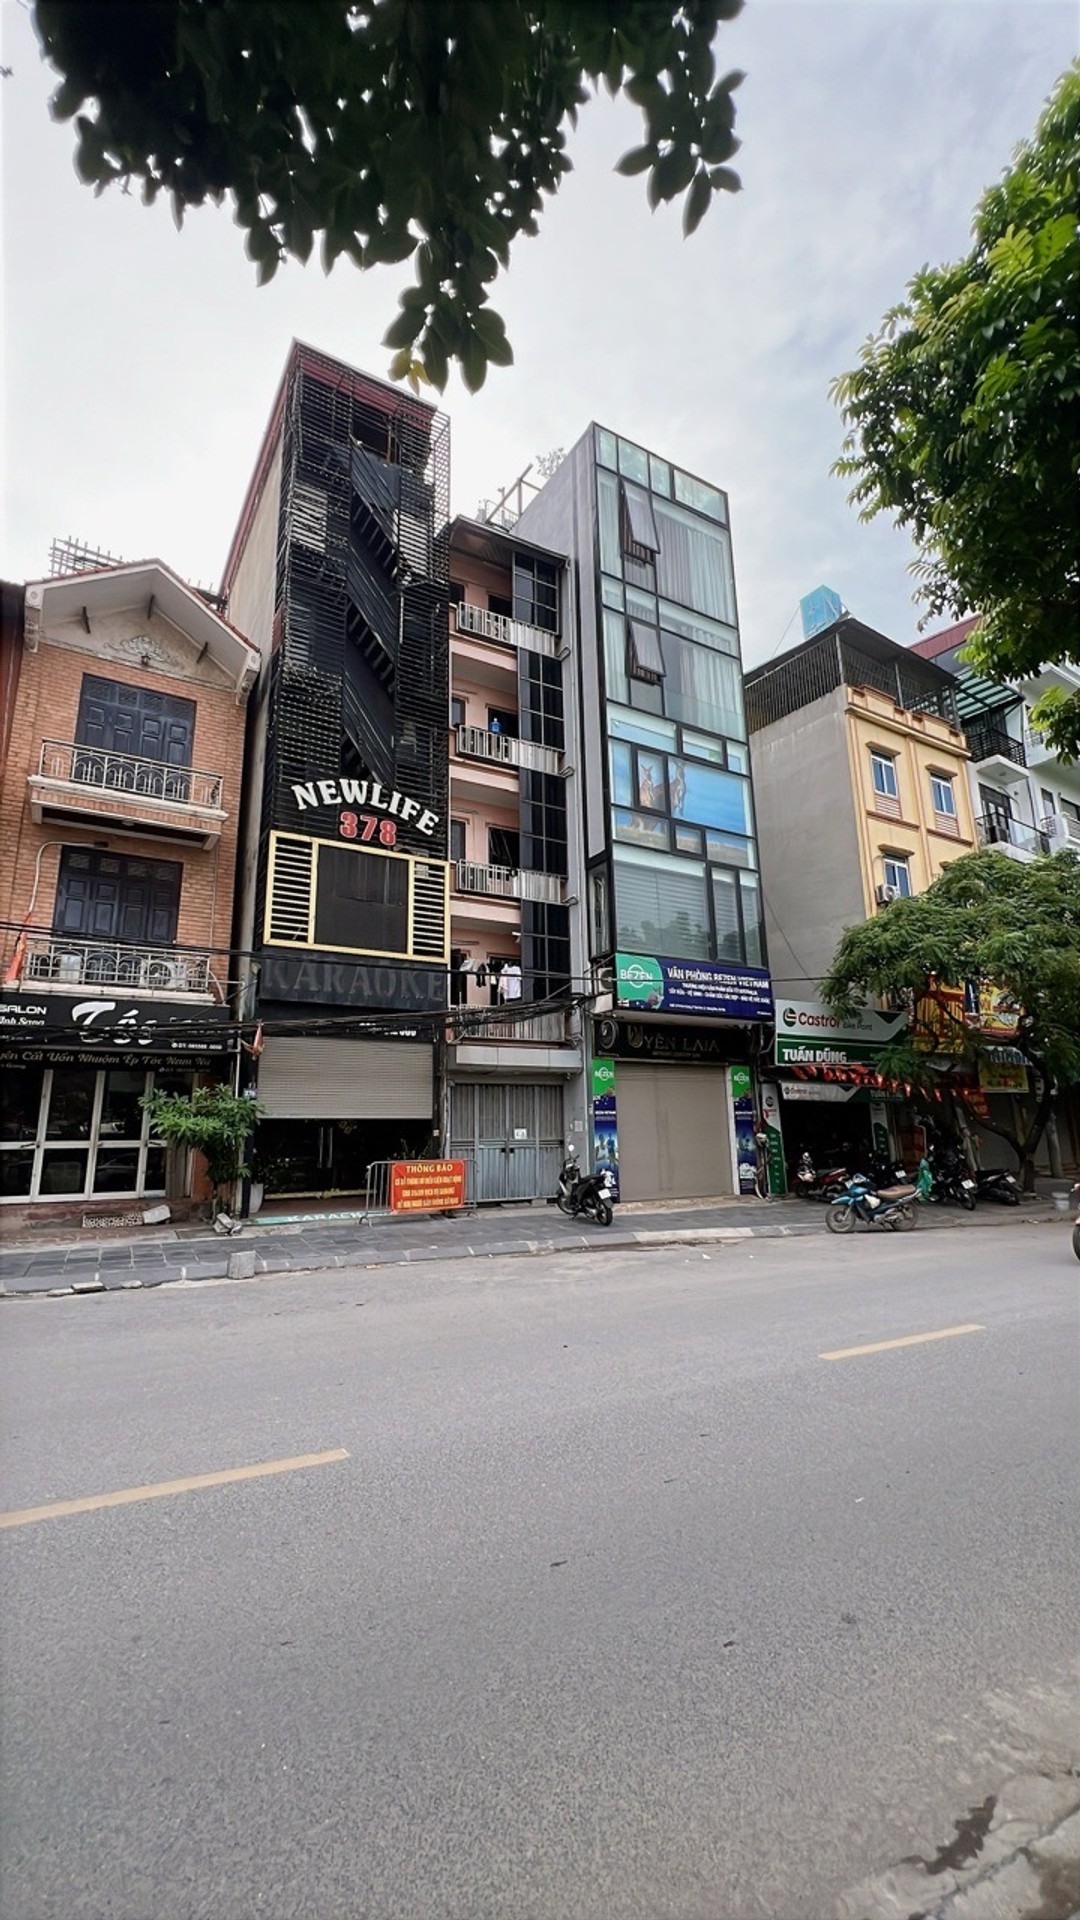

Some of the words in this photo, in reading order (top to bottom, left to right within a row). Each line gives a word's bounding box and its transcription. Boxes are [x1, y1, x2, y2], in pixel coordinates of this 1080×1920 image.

[291, 778, 439, 835] NEWLIFE
[339, 811, 397, 845] 378
[264, 957, 446, 1001] KARAOKE
[0, 1004, 47, 1015] SALON
[782, 1046, 814, 1062] TUẤN
[815, 1048, 847, 1063] DŨNG
[406, 1163, 435, 1173] THÔNG
